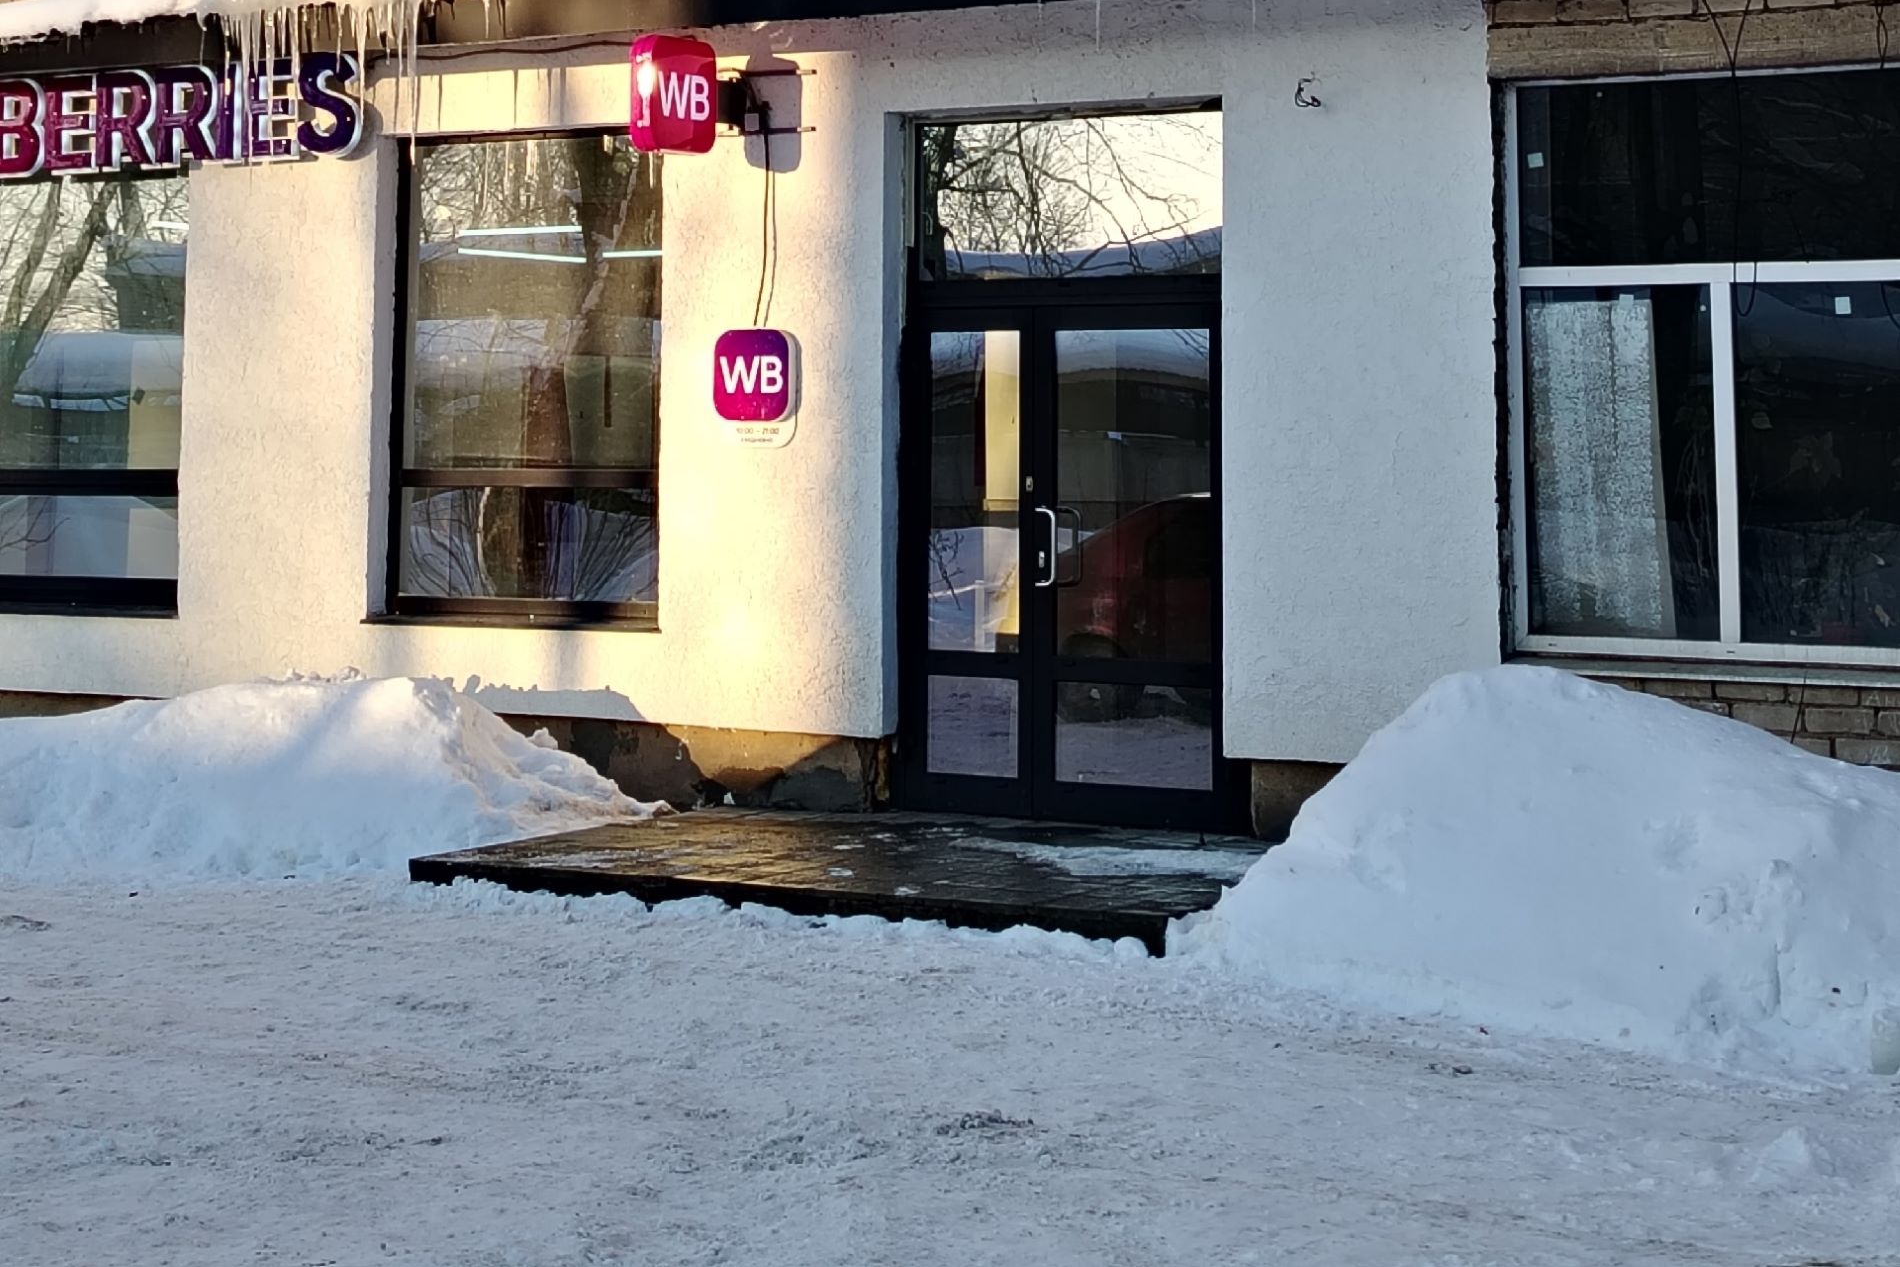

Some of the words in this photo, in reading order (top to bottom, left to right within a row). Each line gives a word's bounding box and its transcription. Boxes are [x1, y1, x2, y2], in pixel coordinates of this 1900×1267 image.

[0, 52, 364, 178] BERRIES
[658, 71, 710, 121] WB
[720, 355, 784, 394] WB
